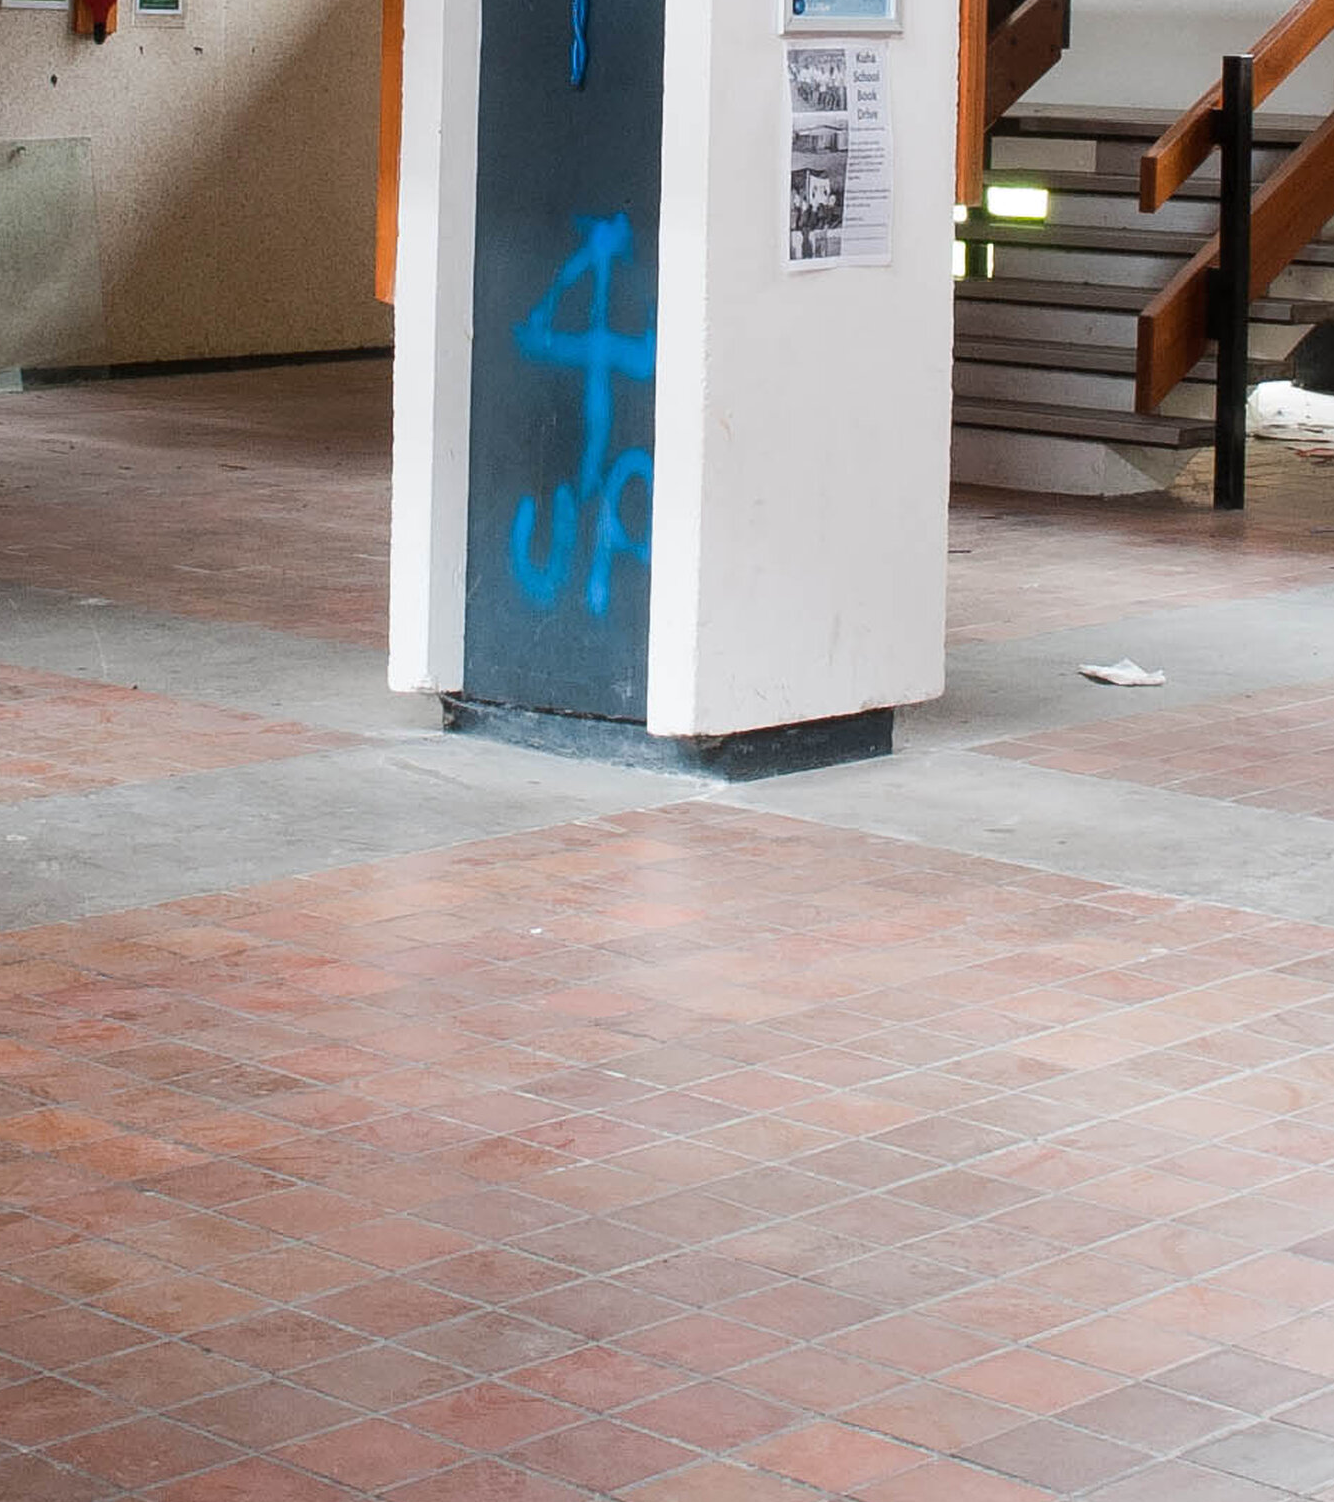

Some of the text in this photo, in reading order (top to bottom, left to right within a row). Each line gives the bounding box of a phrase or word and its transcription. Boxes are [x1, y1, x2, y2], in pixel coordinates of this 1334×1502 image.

[853, 69, 880, 83] School
[857, 89, 877, 102] Book
[857, 108, 878, 121] Drive
